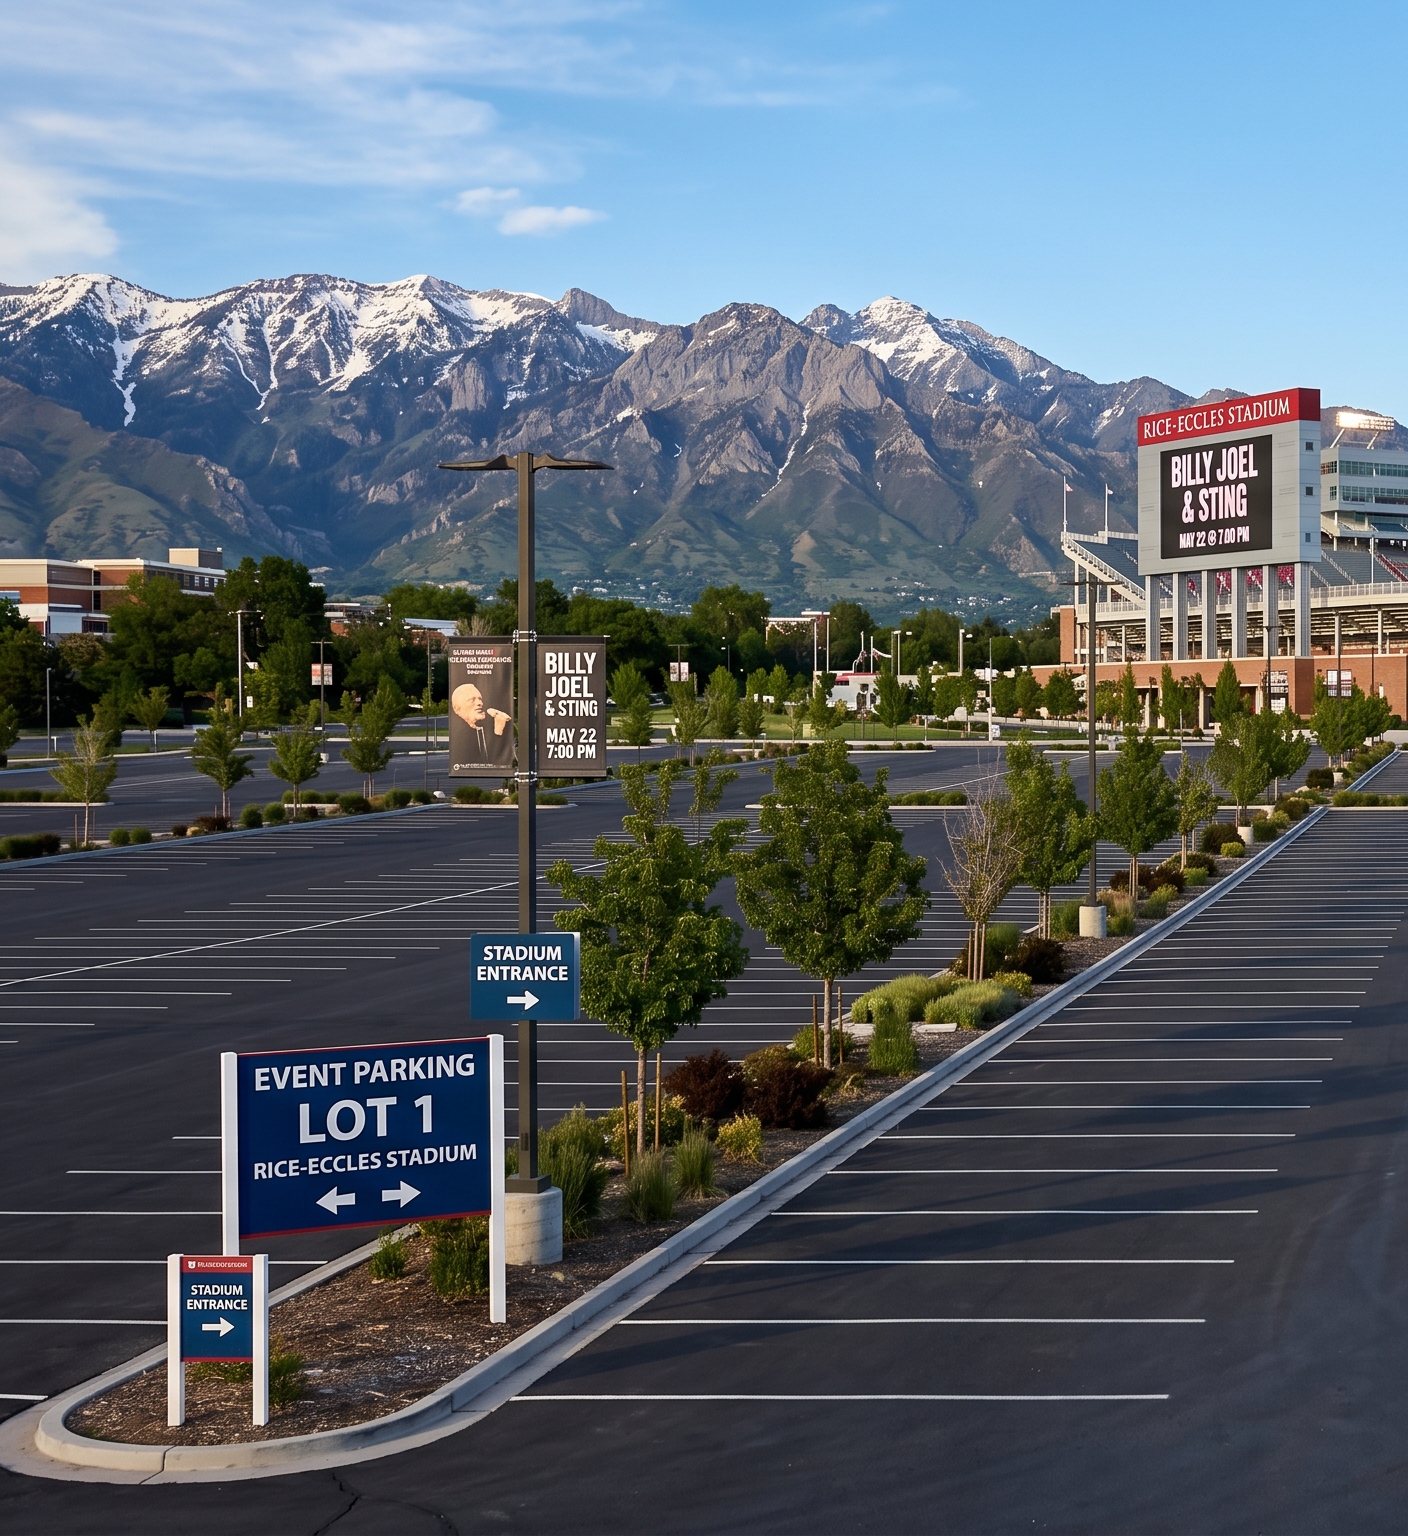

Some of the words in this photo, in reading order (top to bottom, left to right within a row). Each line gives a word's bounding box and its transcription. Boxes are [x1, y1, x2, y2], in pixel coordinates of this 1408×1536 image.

[1143, 408, 1224, 439] RICE-ECCLES
[1228, 396, 1290, 425] STADIUM
[1171, 450, 1214, 488] BILLY
[1216, 443, 1259, 482] JOEL
[1181, 490, 1195, 524] &
[1198, 482, 1248, 522] STING
[1179, 531, 1195, 549] MAY
[1196, 530, 1206, 547] 22
[1237, 525, 1250, 542] PM
[545, 652, 597, 675] BILLY
[545, 676, 594, 698] JOEL
[545, 700, 555, 717] &
[558, 700, 598, 717] STING
[546, 728, 575, 743] MAY
[579, 728, 597, 743] 22
[547, 744, 574, 759] 7:00
[577, 744, 596, 759] PM
[483, 945, 562, 962] STADIUM
[476, 966, 569, 982] ENTRANCE
[254, 1062, 347, 1092] EVENT
[354, 1053, 475, 1085] PARKING
[299, 1096, 397, 1144] LOT
[414, 1094, 433, 1134] 1
[254, 1152, 382, 1180] RICE-ECCLES
[386, 1143, 478, 1168] STADIUM
[190, 1284, 243, 1296] STADIUM
[186, 1299, 248, 1310] ENTRANCE
